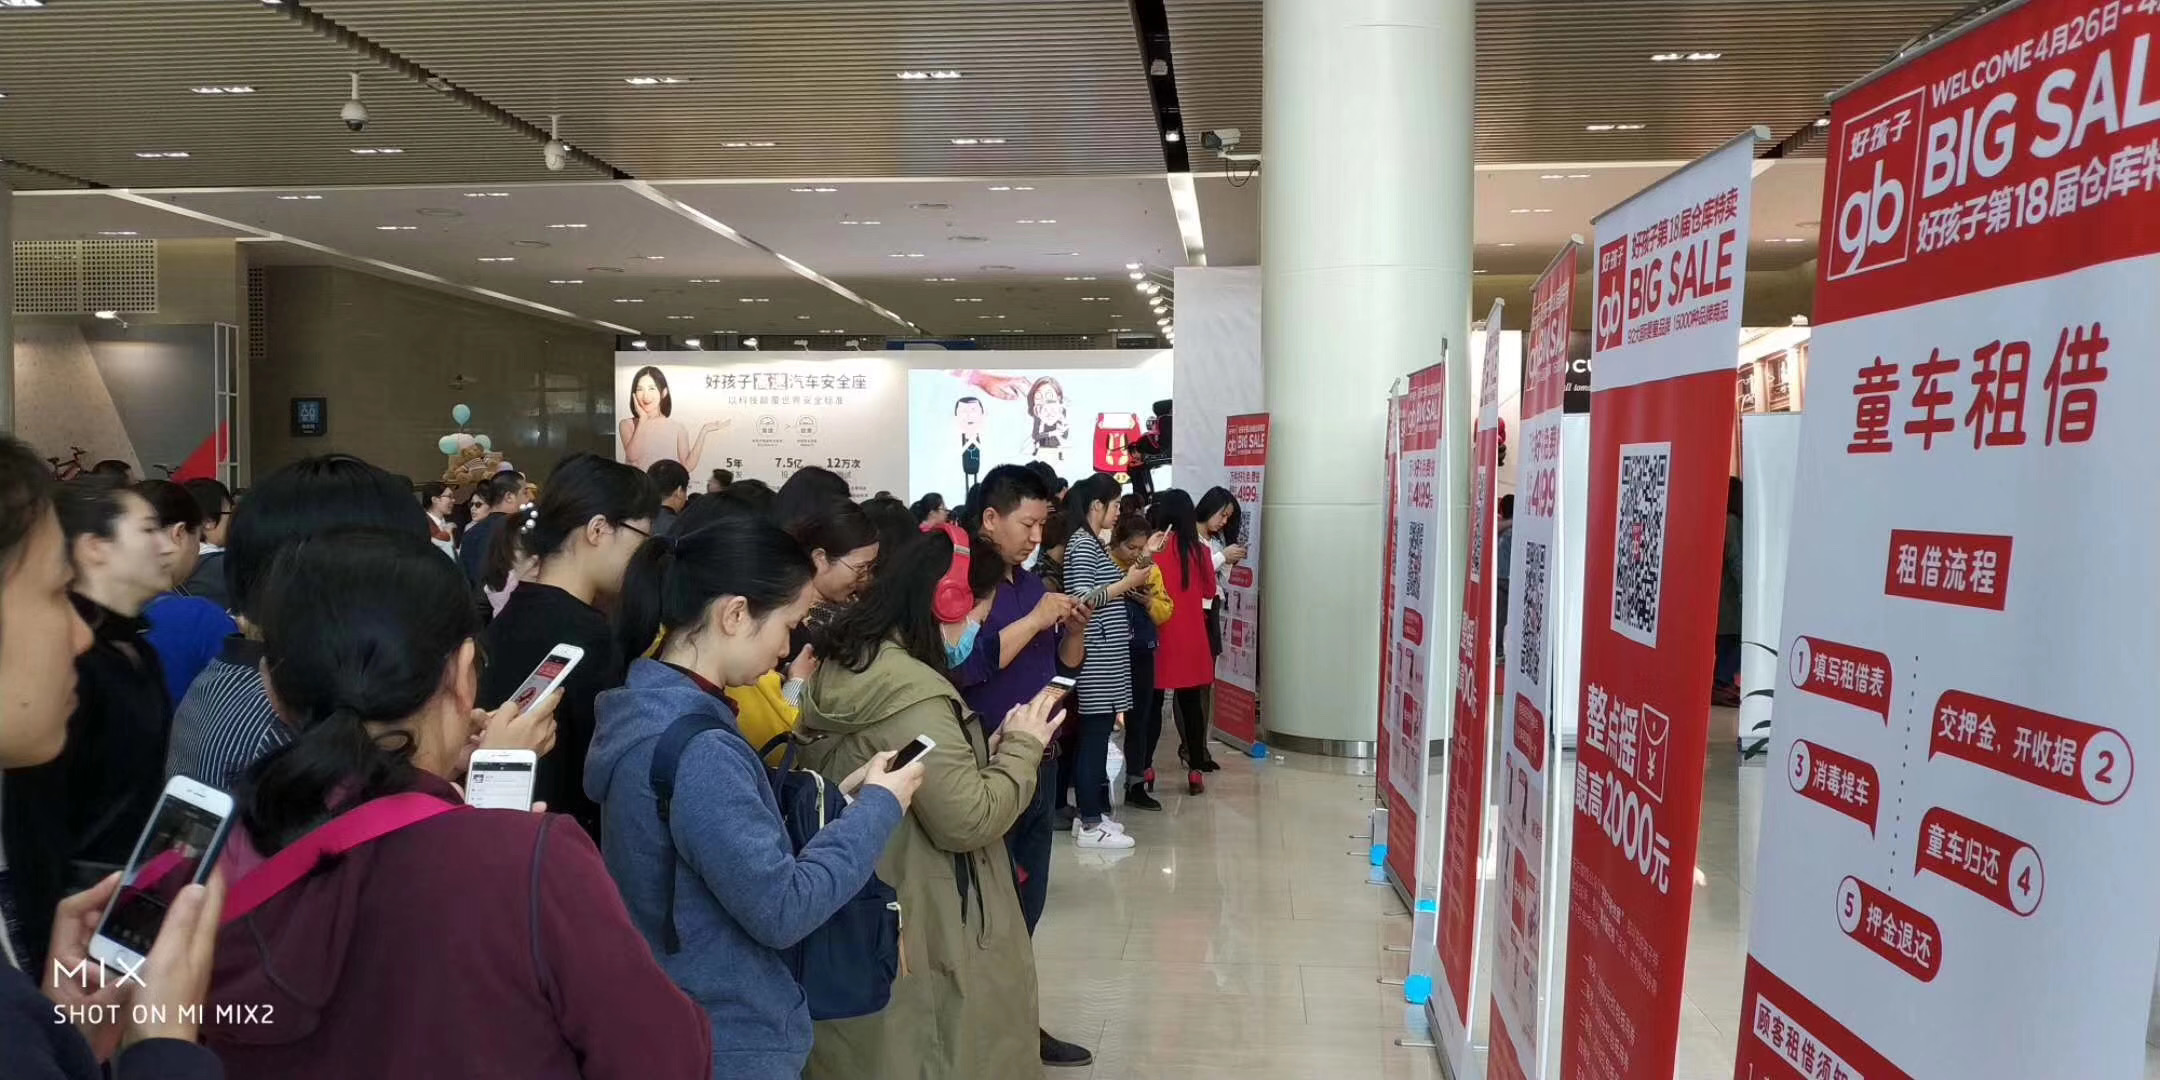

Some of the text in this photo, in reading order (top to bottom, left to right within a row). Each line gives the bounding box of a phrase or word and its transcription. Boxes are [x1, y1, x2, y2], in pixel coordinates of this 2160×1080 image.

[1932, 39, 2035, 108] WELCOME
[1849, 109, 1912, 162] 好孩子
[1921, 92, 2019, 199] BIG
[1632, 187, 1738, 260] 好孩子第18届仓库特卖
[1838, 159, 1904, 274] gb
[1628, 258, 1662, 320] BIG
[1668, 228, 1736, 307] SALE
[1599, 276, 1621, 351] gb
[705, 374, 751, 390] 好孩子
[1847, 321, 2110, 455] 童车租借
[726, 458, 743, 469] 5年
[827, 458, 861, 469] 12万次
[1895, 546, 1998, 595] 租借流程
[1798, 650, 1885, 698] 1 填写租借表
[1586, 683, 1639, 778] 整点摇
[1795, 754, 1871, 807] 3 消毒提车
[2095, 751, 2114, 785] 2
[1575, 760, 1671, 895] 最高2000元
[1926, 823, 2032, 897] 童车归还 4
[1844, 893, 1932, 969] 5 押金退还
